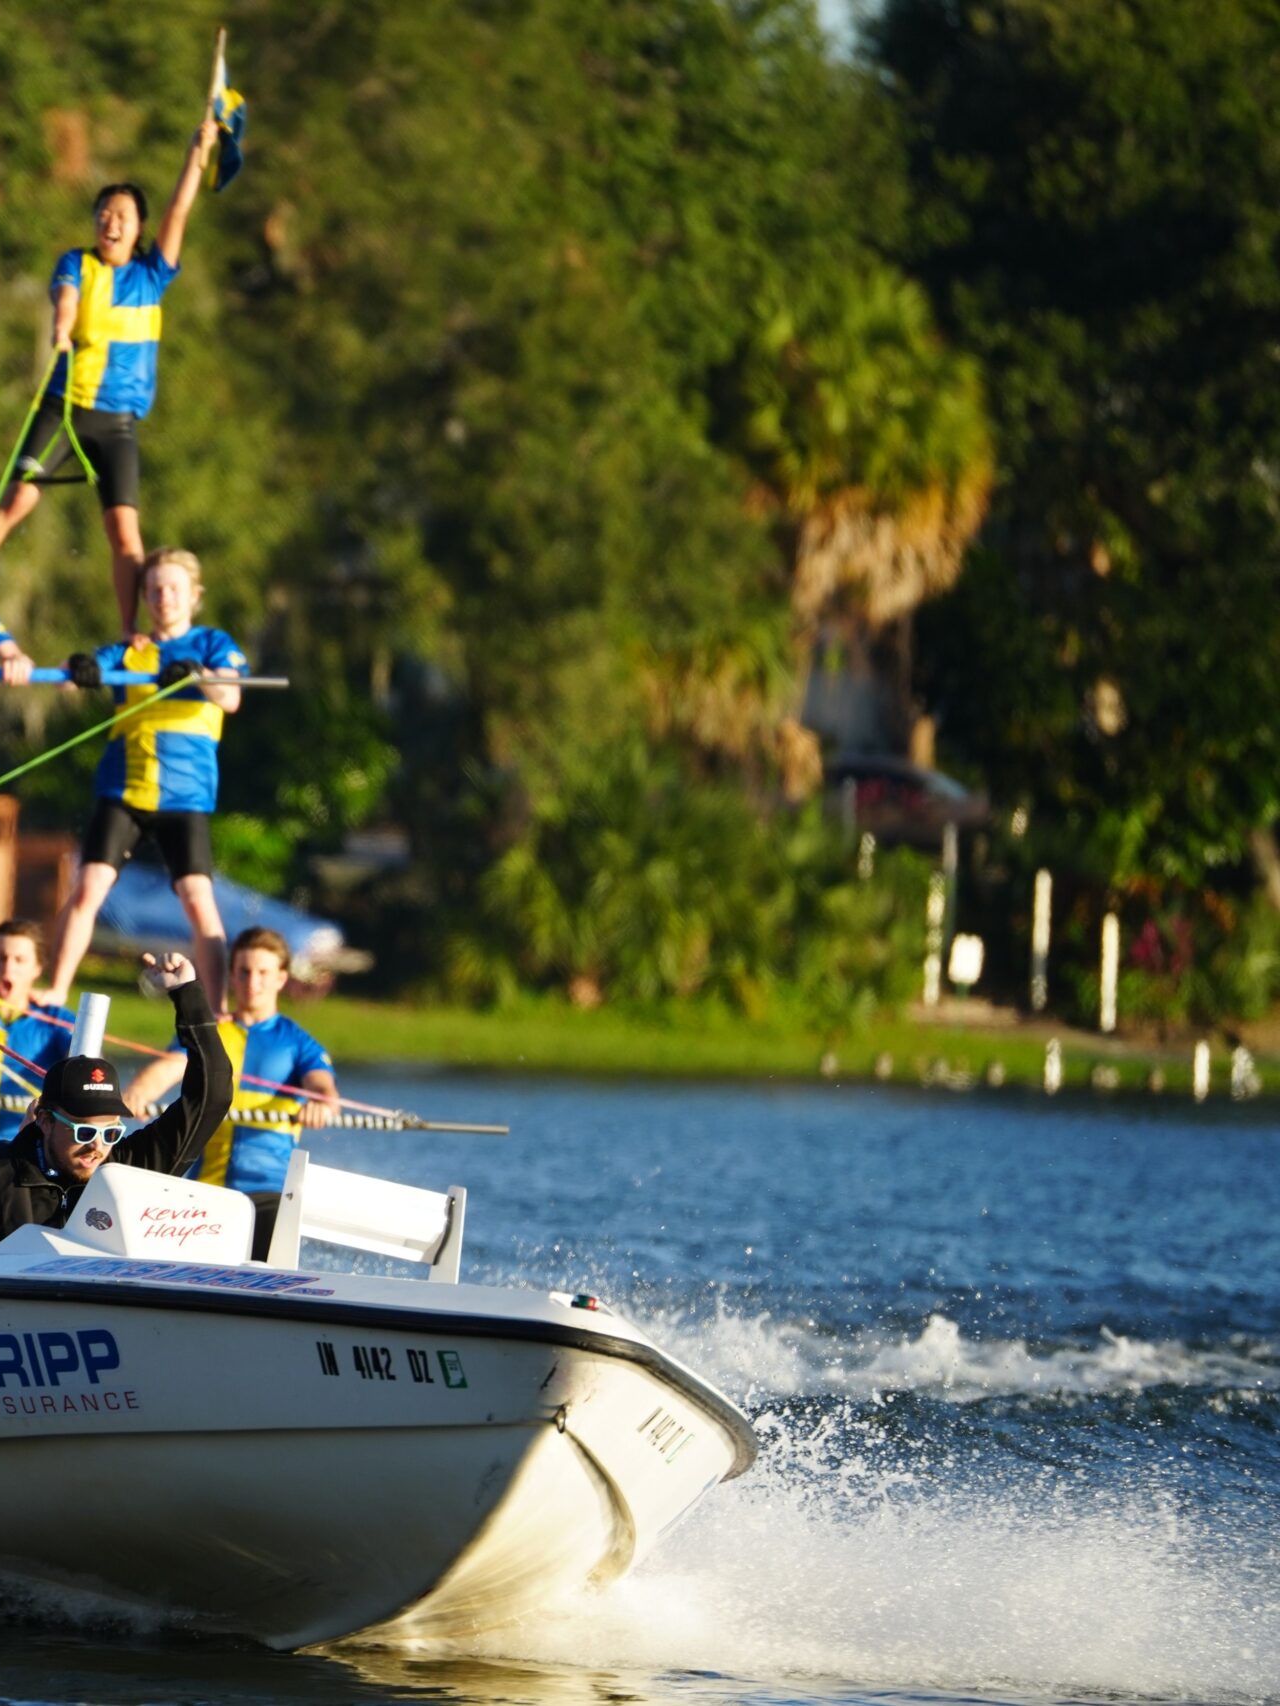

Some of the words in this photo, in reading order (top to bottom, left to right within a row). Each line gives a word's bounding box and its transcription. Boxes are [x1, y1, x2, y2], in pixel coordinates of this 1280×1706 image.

[140, 1206, 207, 1221] Kevin
[143, 1223, 222, 1247] Hayes
[315, 1341, 340, 1376] IN
